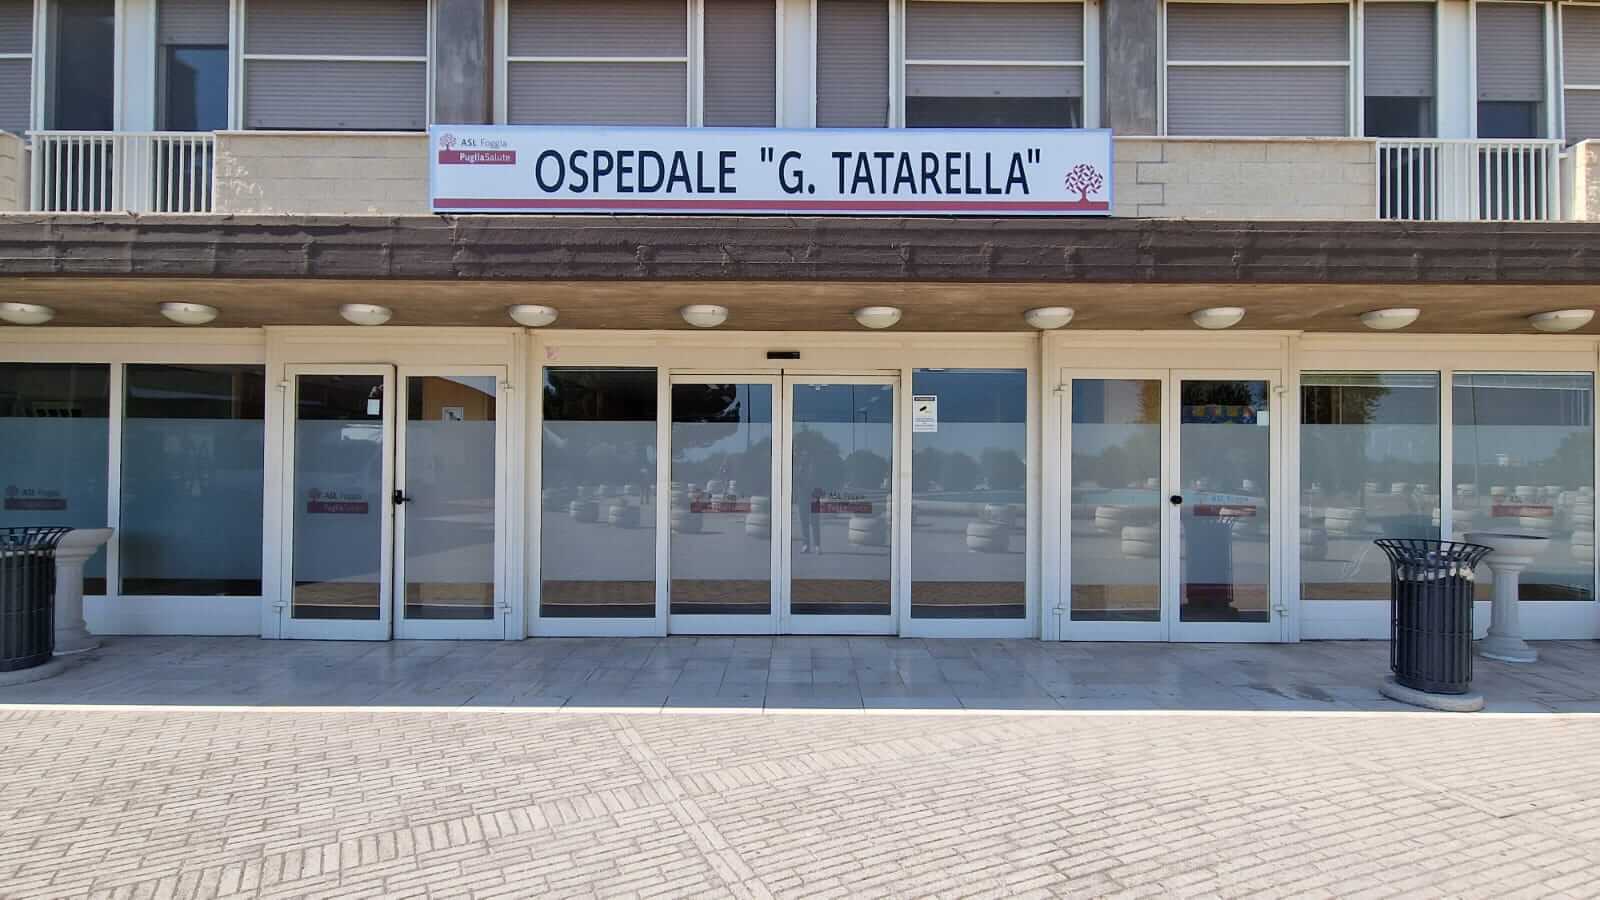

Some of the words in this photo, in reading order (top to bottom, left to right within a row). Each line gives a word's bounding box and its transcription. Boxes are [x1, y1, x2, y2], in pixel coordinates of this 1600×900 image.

[461, 138, 477, 147] ASL
[480, 138, 508, 149] Foggia
[459, 151, 511, 163] PugliaSalute
[535, 149, 737, 194] OSPEDALE
[760, 147, 816, 195] "G.
[831, 148, 1041, 195] TATARELLA"
